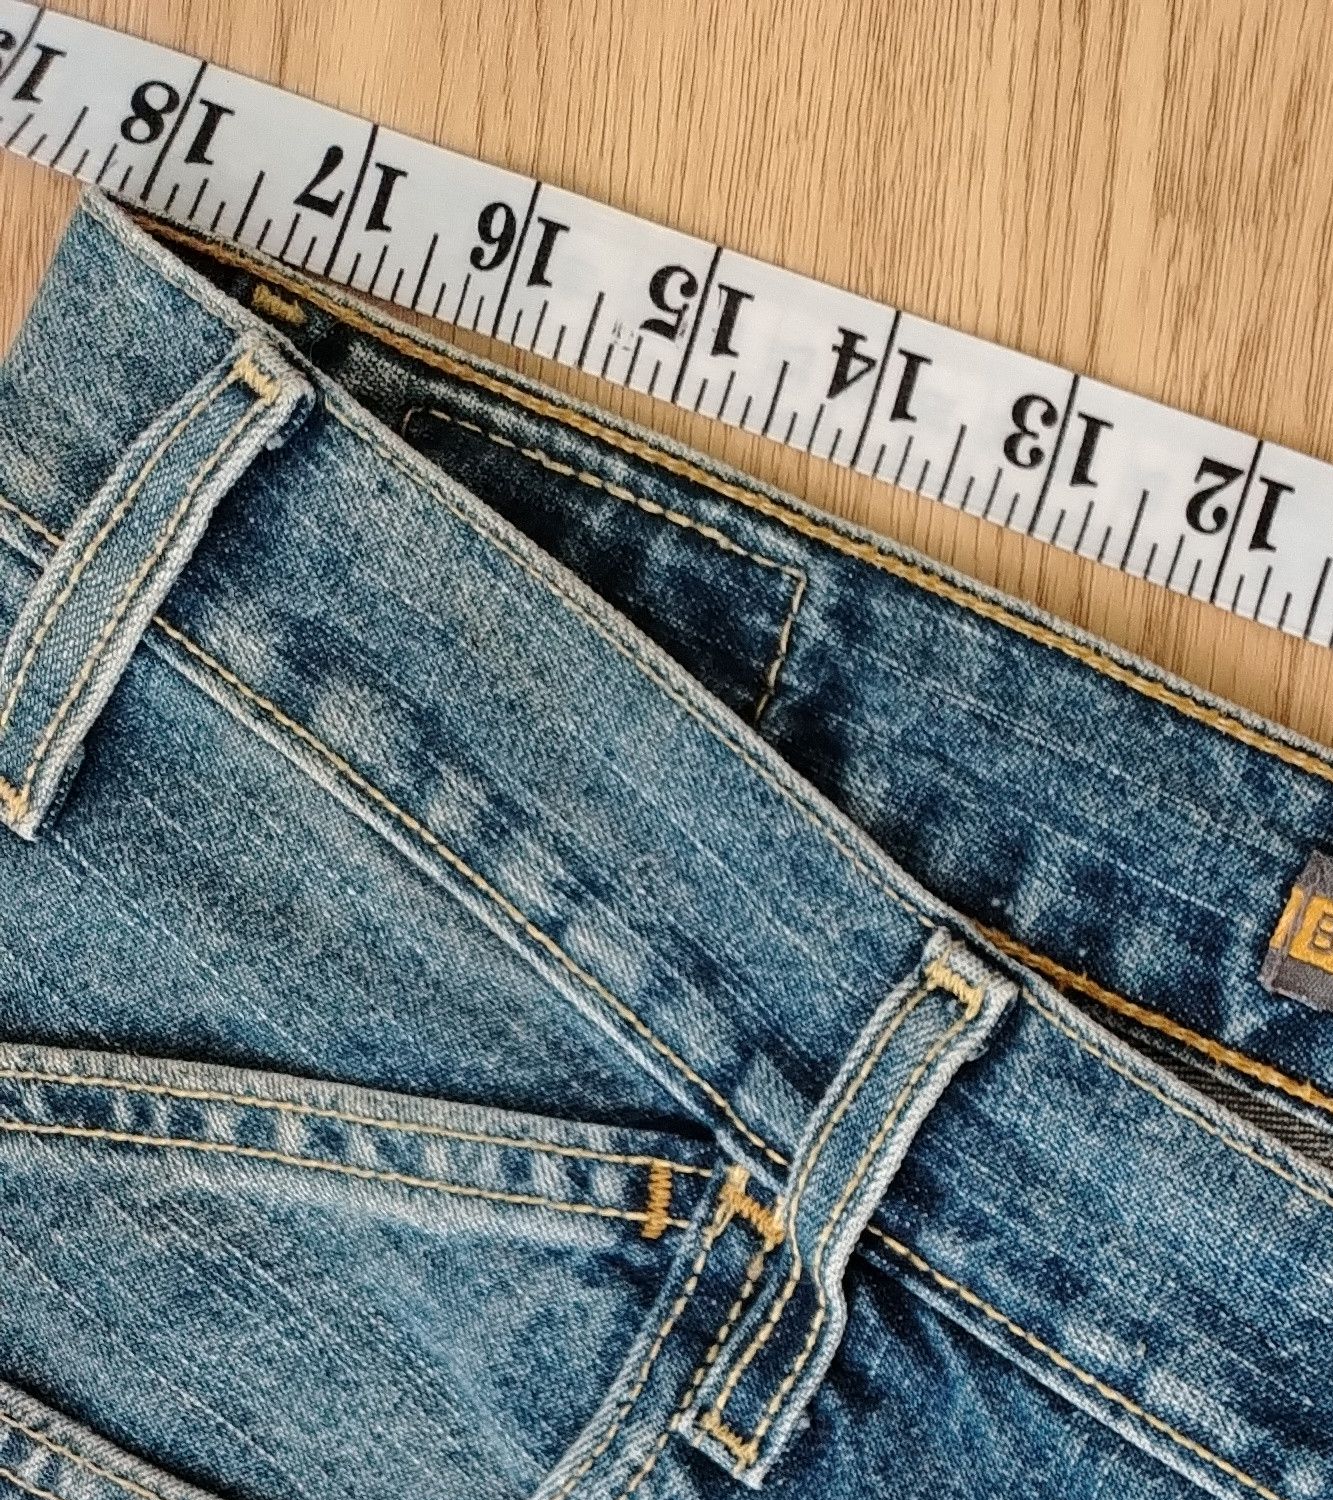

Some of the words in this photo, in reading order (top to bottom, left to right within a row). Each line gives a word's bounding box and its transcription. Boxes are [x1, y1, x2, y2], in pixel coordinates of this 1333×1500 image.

[120, 80, 235, 165] 18
[294, 146, 407, 232] 17
[470, 202, 569, 287] 16
[641, 264, 754, 357] 15
[825, 327, 932, 421] 14
[1003, 393, 1114, 487] 13
[1185, 456, 1294, 551] 12
